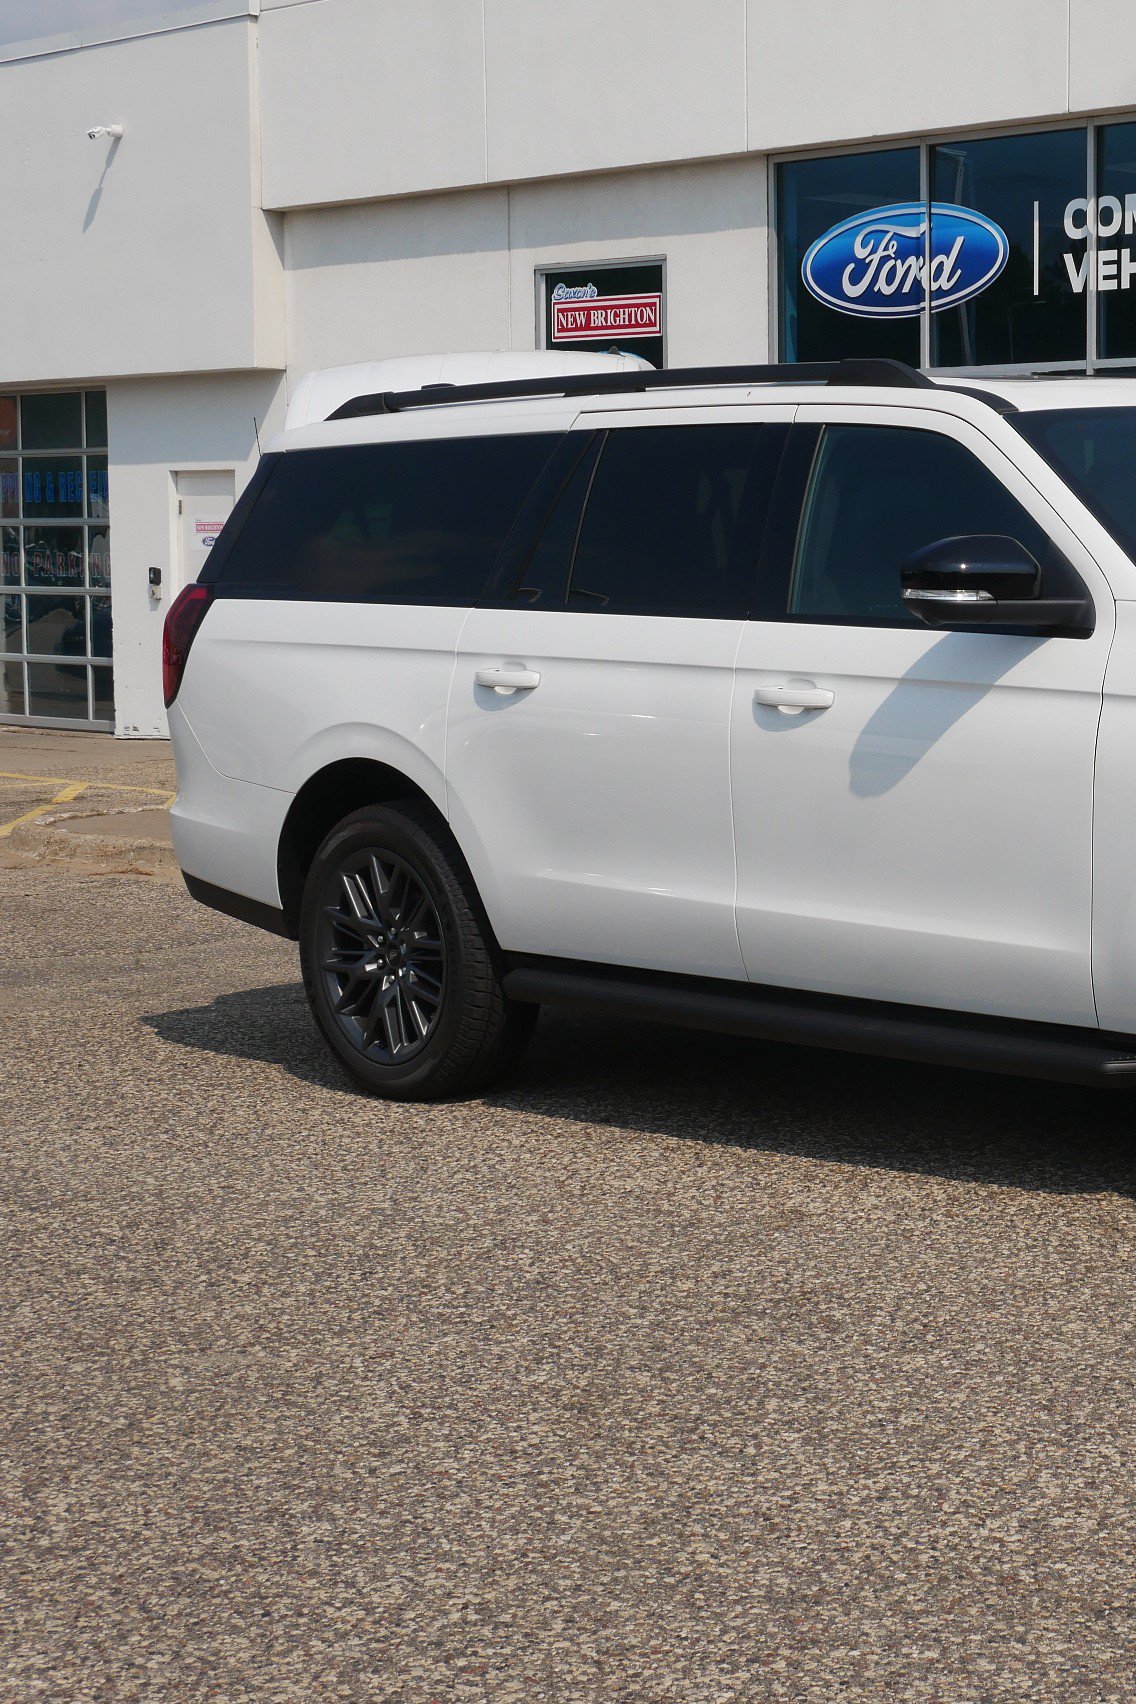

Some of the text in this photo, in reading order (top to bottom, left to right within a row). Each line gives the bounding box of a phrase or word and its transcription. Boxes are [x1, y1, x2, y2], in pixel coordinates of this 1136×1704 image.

[842, 221, 966, 299] Ford
[553, 283, 597, 300] Saxon's
[558, 306, 655, 328] NEW BRIGHTON
